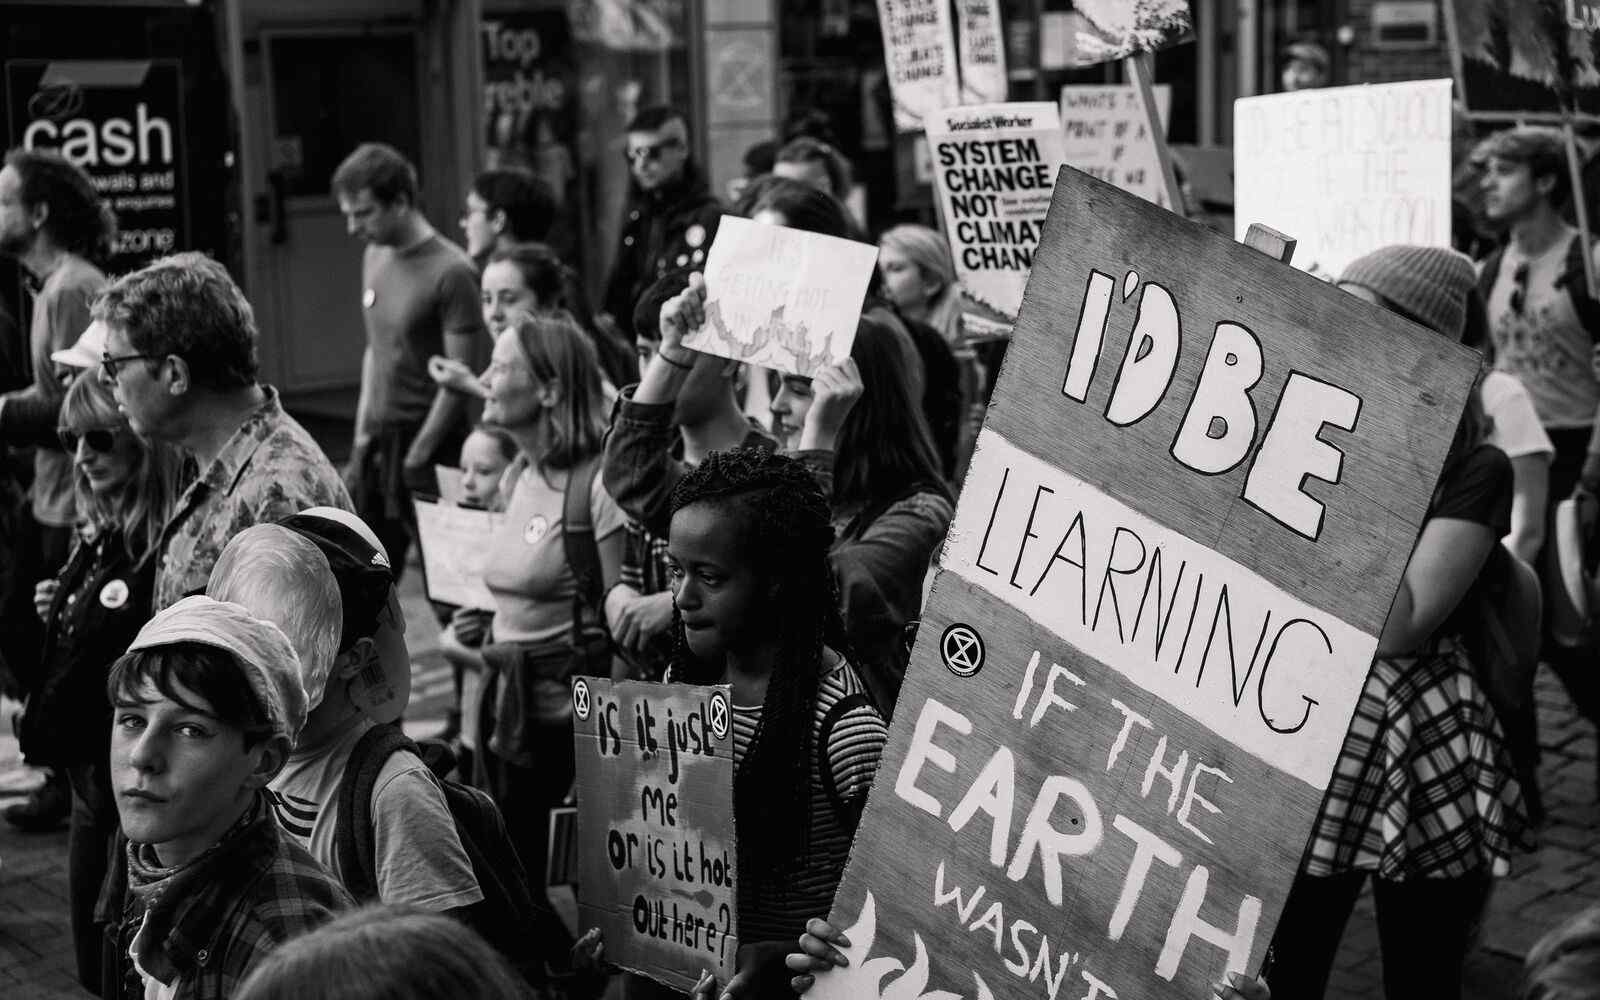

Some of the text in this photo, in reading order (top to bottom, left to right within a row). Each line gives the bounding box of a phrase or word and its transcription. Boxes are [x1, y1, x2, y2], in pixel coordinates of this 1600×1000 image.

[24, 103, 173, 167] cash
[946, 115, 1034, 132] Socialist Worker
[937, 138, 1041, 166] SYSTEM
[140, 169, 175, 191] and
[945, 165, 1052, 192] CHANGE
[951, 194, 998, 219] NOT
[111, 228, 175, 253] zone
[957, 219, 1045, 245] CLIMAT
[962, 246, 1037, 271] CHAN
[1061, 268, 1364, 543] I'D BE
[976, 468, 1335, 734] LEARNING
[597, 696, 715, 785] is it just
[1012, 650, 1235, 846] IF THE
[647, 834, 666, 879] is
[673, 840, 694, 883] it
[700, 841, 732, 888] hot
[895, 698, 1263, 999] EARTH
